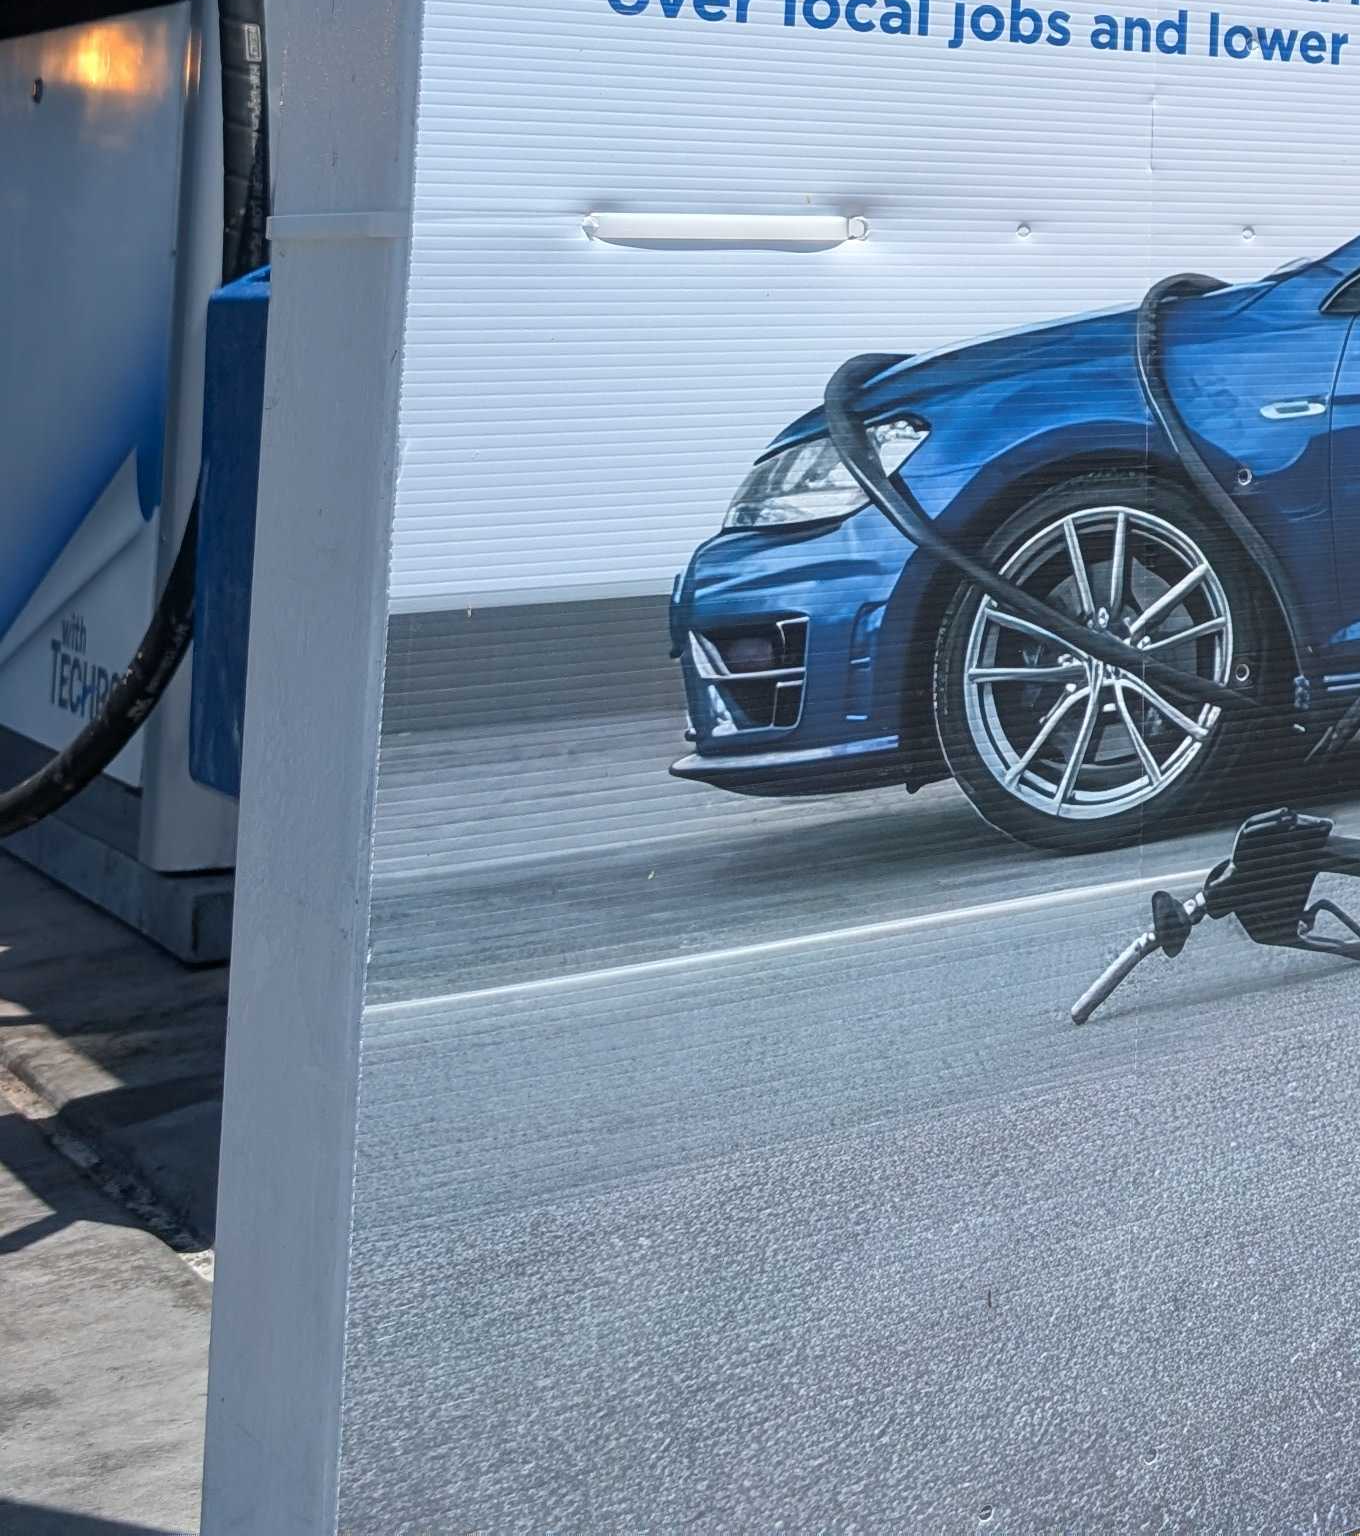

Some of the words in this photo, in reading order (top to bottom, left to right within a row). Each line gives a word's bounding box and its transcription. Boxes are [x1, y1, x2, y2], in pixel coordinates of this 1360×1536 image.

[1089, 9, 1189, 56] and
[1207, 11, 1350, 67] lower
[61, 611, 88, 654] with
[50, 638, 122, 722] TECHR
